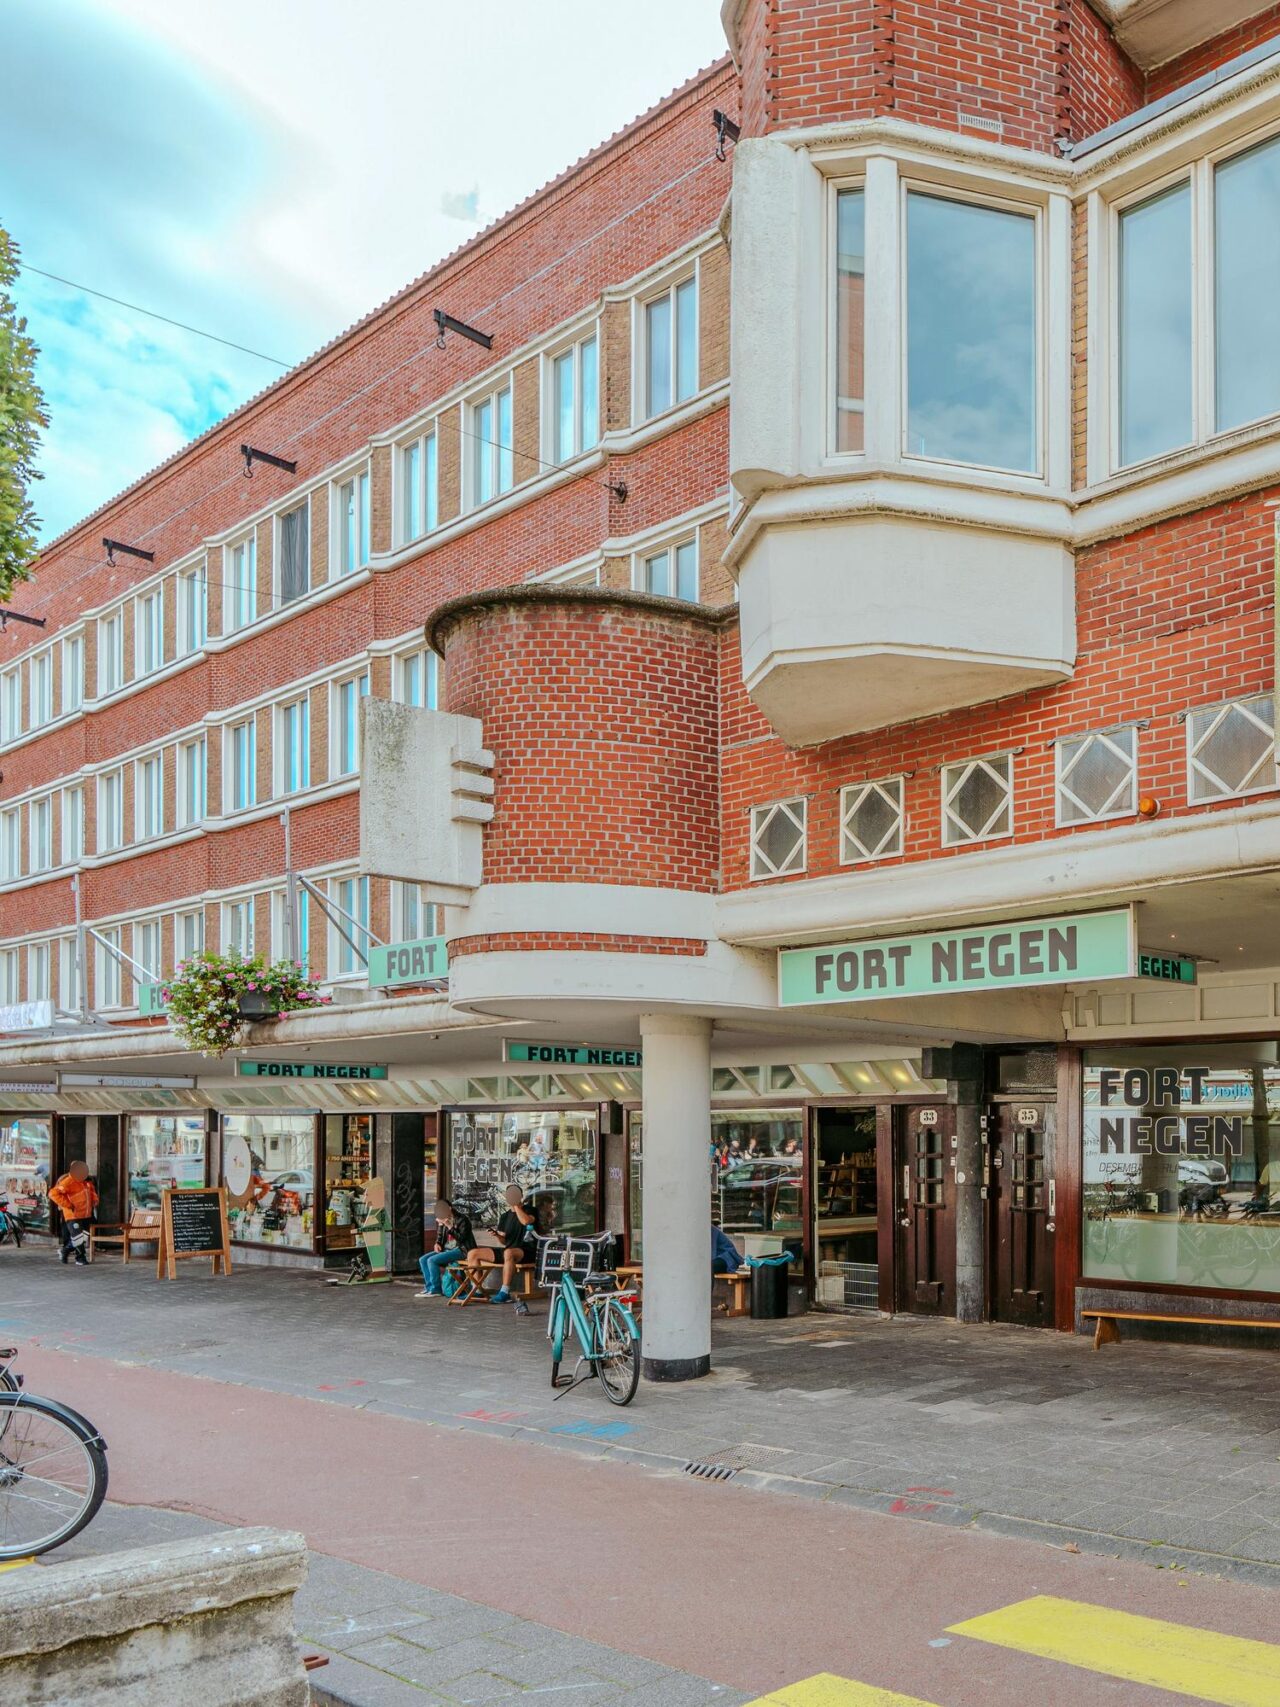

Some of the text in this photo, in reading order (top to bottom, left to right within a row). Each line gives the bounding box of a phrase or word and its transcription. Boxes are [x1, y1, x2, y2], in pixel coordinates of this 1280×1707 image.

[387, 944, 437, 979] FORT
[815, 925, 1077, 994] FORT NEGEN
[1140, 955, 1181, 980] EGEN
[150, 988, 166, 1010] FO
[528, 1046, 578, 1063] FORT
[257, 1063, 370, 1079] FORT NEGEN
[1100, 1067, 1210, 1107] FORT
[923, 1112, 934, 1121] 33
[1021, 1111, 1034, 1120] 35
[452, 1126, 499, 1151] FORT
[1100, 1116, 1243, 1155] NEGEN
[452, 1157, 513, 1182] NEGEN
